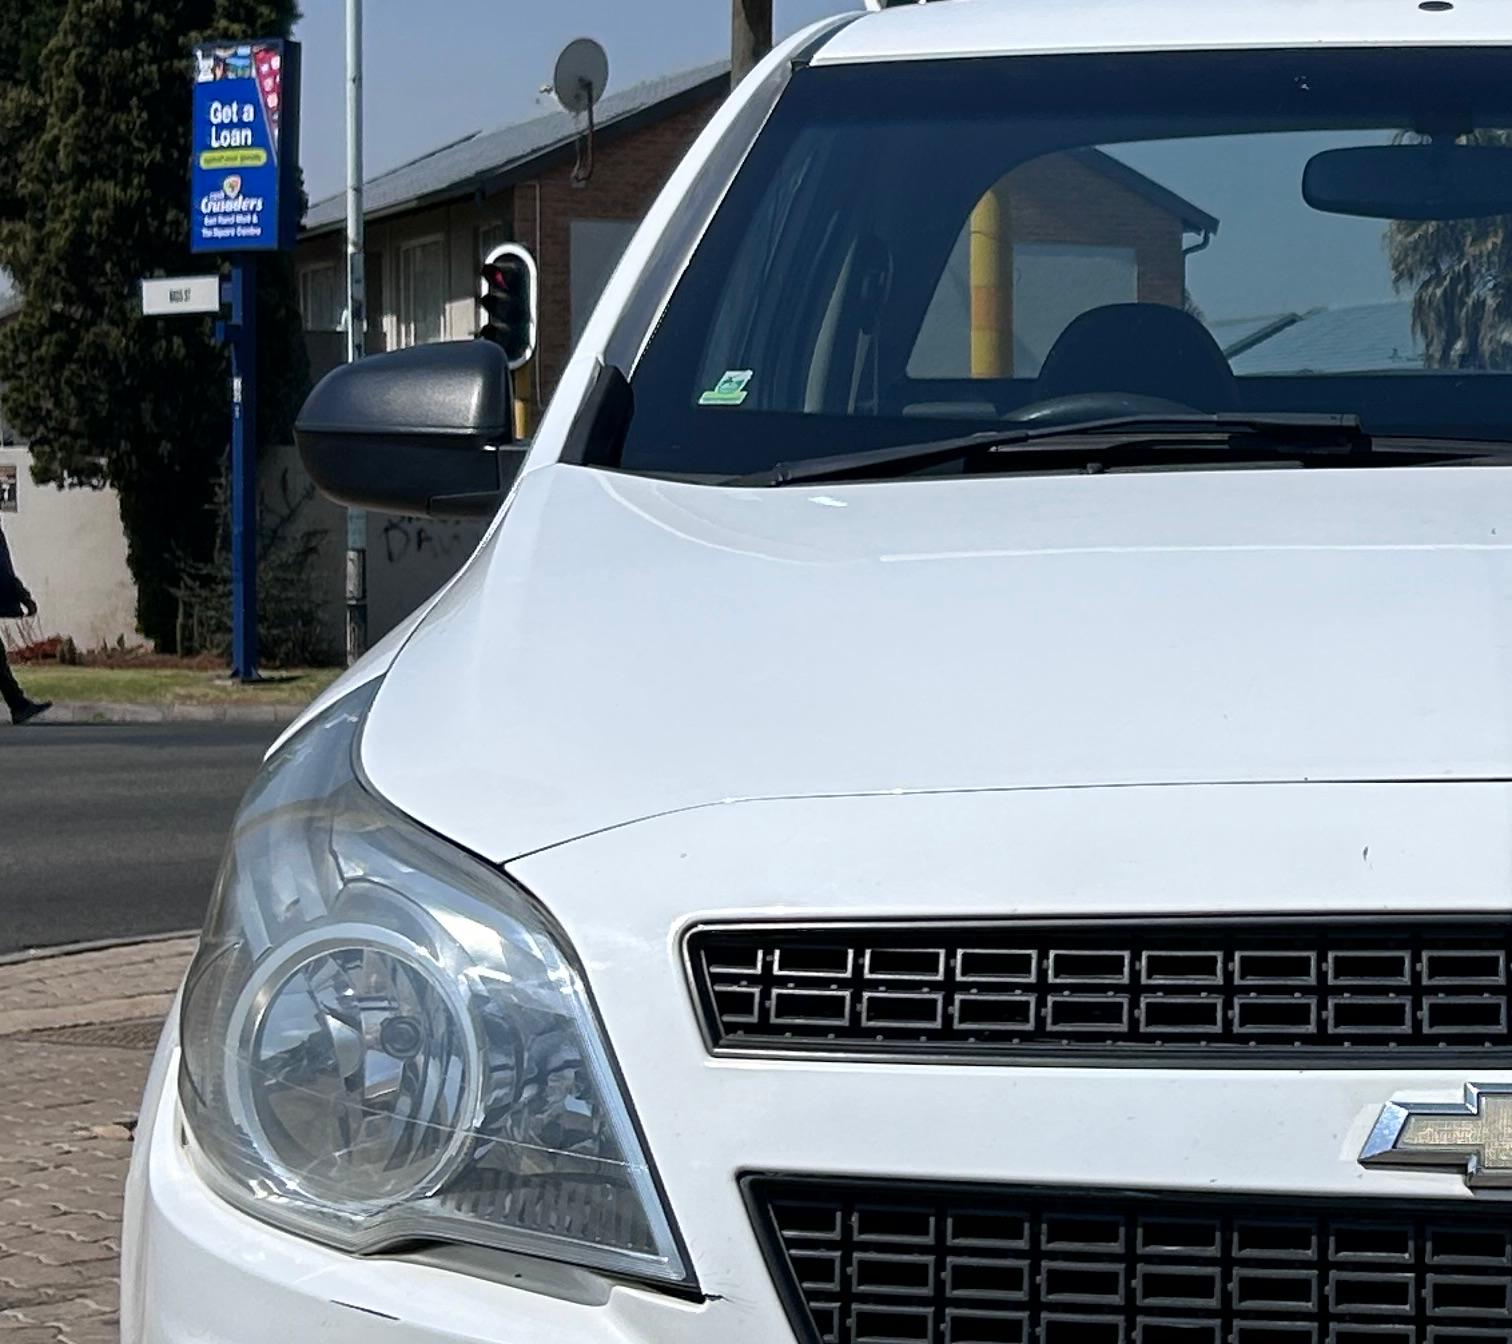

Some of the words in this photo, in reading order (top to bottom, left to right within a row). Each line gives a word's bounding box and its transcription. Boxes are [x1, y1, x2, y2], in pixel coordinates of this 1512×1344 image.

[210, 100, 239, 125] Get
[242, 103, 255, 123] a
[211, 125, 252, 148] Loan
